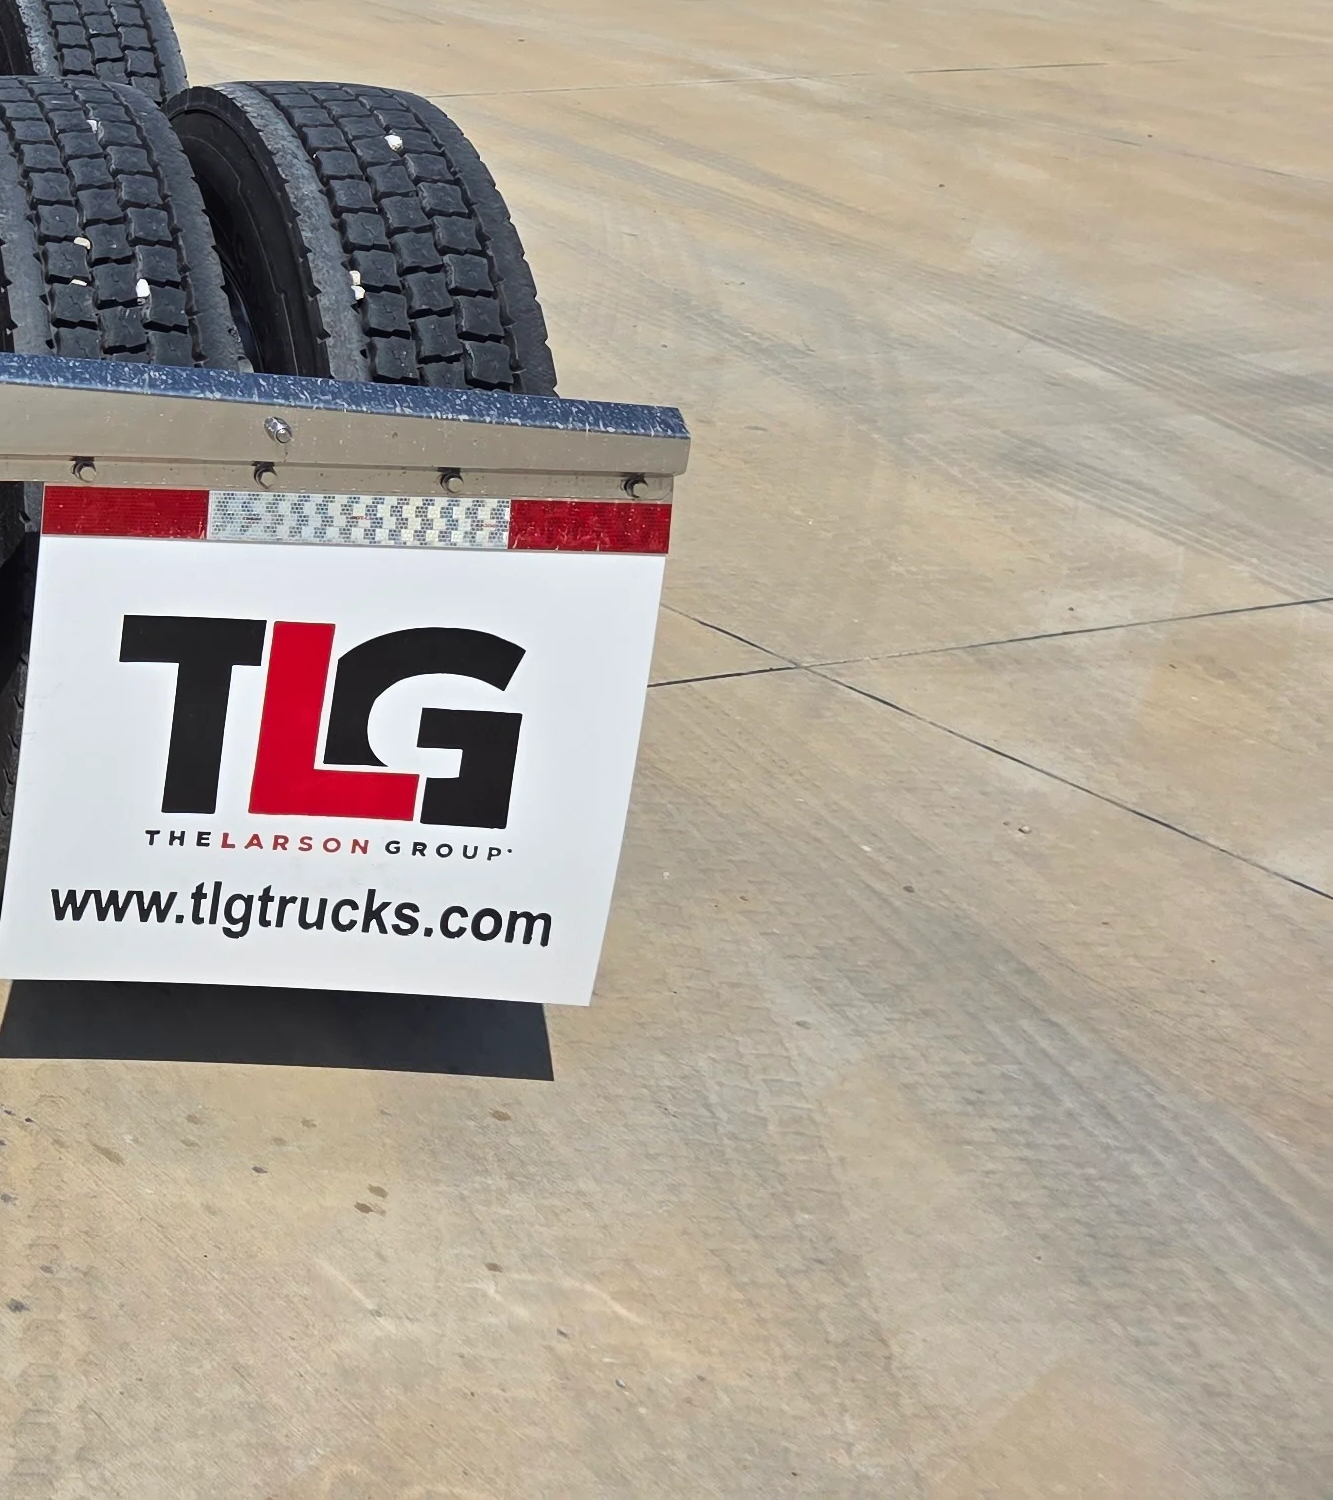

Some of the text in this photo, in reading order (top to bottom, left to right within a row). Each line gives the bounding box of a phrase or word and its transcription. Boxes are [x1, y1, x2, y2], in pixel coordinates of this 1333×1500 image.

[119, 614, 527, 830] TLG
[384, 840, 502, 861] GROUP
[50, 880, 552, 948] www.tlgtrucks.com
